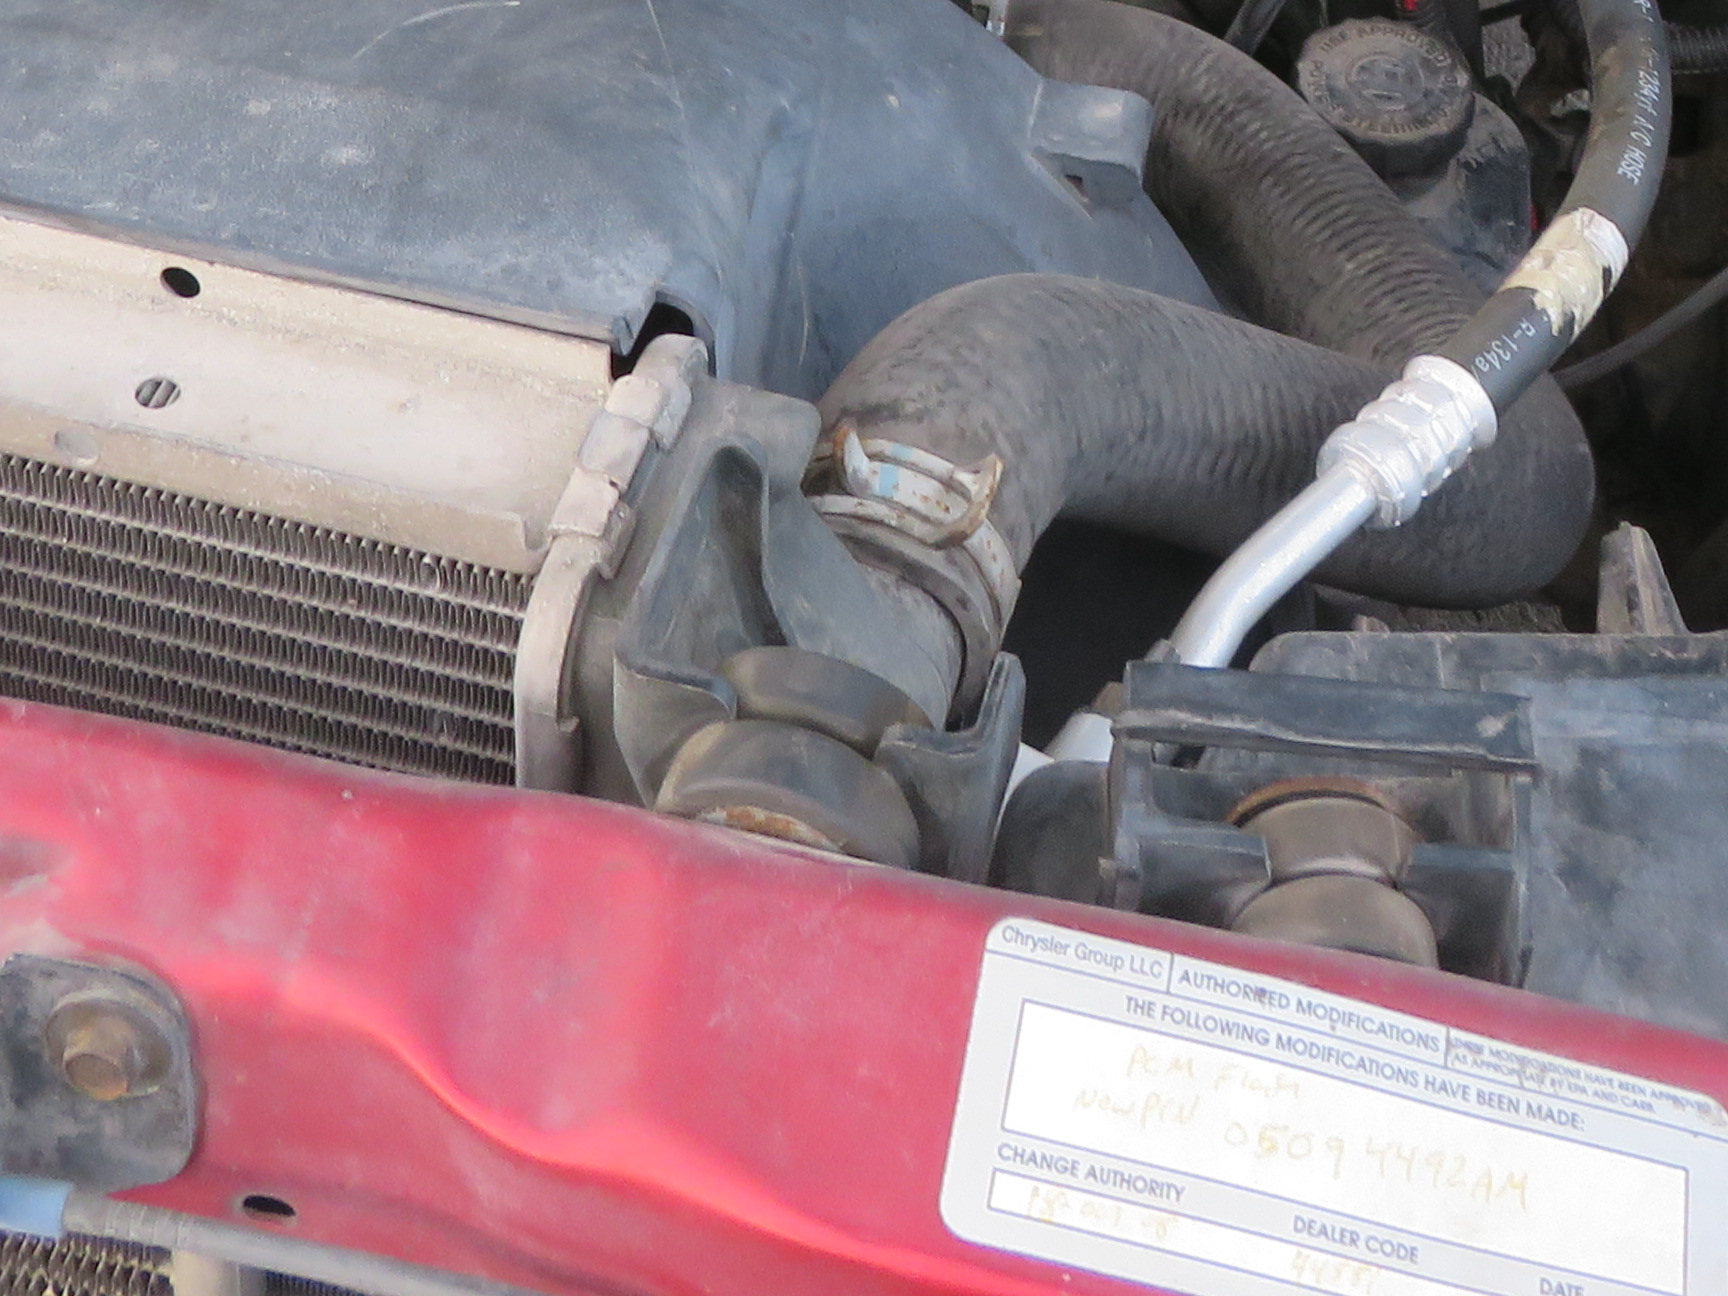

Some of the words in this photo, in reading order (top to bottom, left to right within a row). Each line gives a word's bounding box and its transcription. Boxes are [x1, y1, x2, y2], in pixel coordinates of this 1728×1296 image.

[1616, 143, 1649, 187] HOSE
[1002, 925, 1071, 956] Chrysler
[1074, 941, 1125, 971] Group
[1129, 955, 1164, 979] LLC
[1295, 998, 1440, 1053] MODIFICATIONS
[1125, 994, 1158, 1020] THE
[1161, 1004, 1270, 1047] FOLLOWING
[1275, 1032, 1420, 1089] MODIFICATIONS
[1424, 1074, 1471, 1103] HAVE
[1475, 1087, 1522, 1115] BEEN
[1525, 1100, 1586, 1132] MADE:
[997, 1142, 1081, 1178] CHANGE
[1083, 1163, 1187, 1204] AUTHORITY
[1292, 1214, 1361, 1250] DEALER
[1364, 1234, 1420, 1265] CODE
